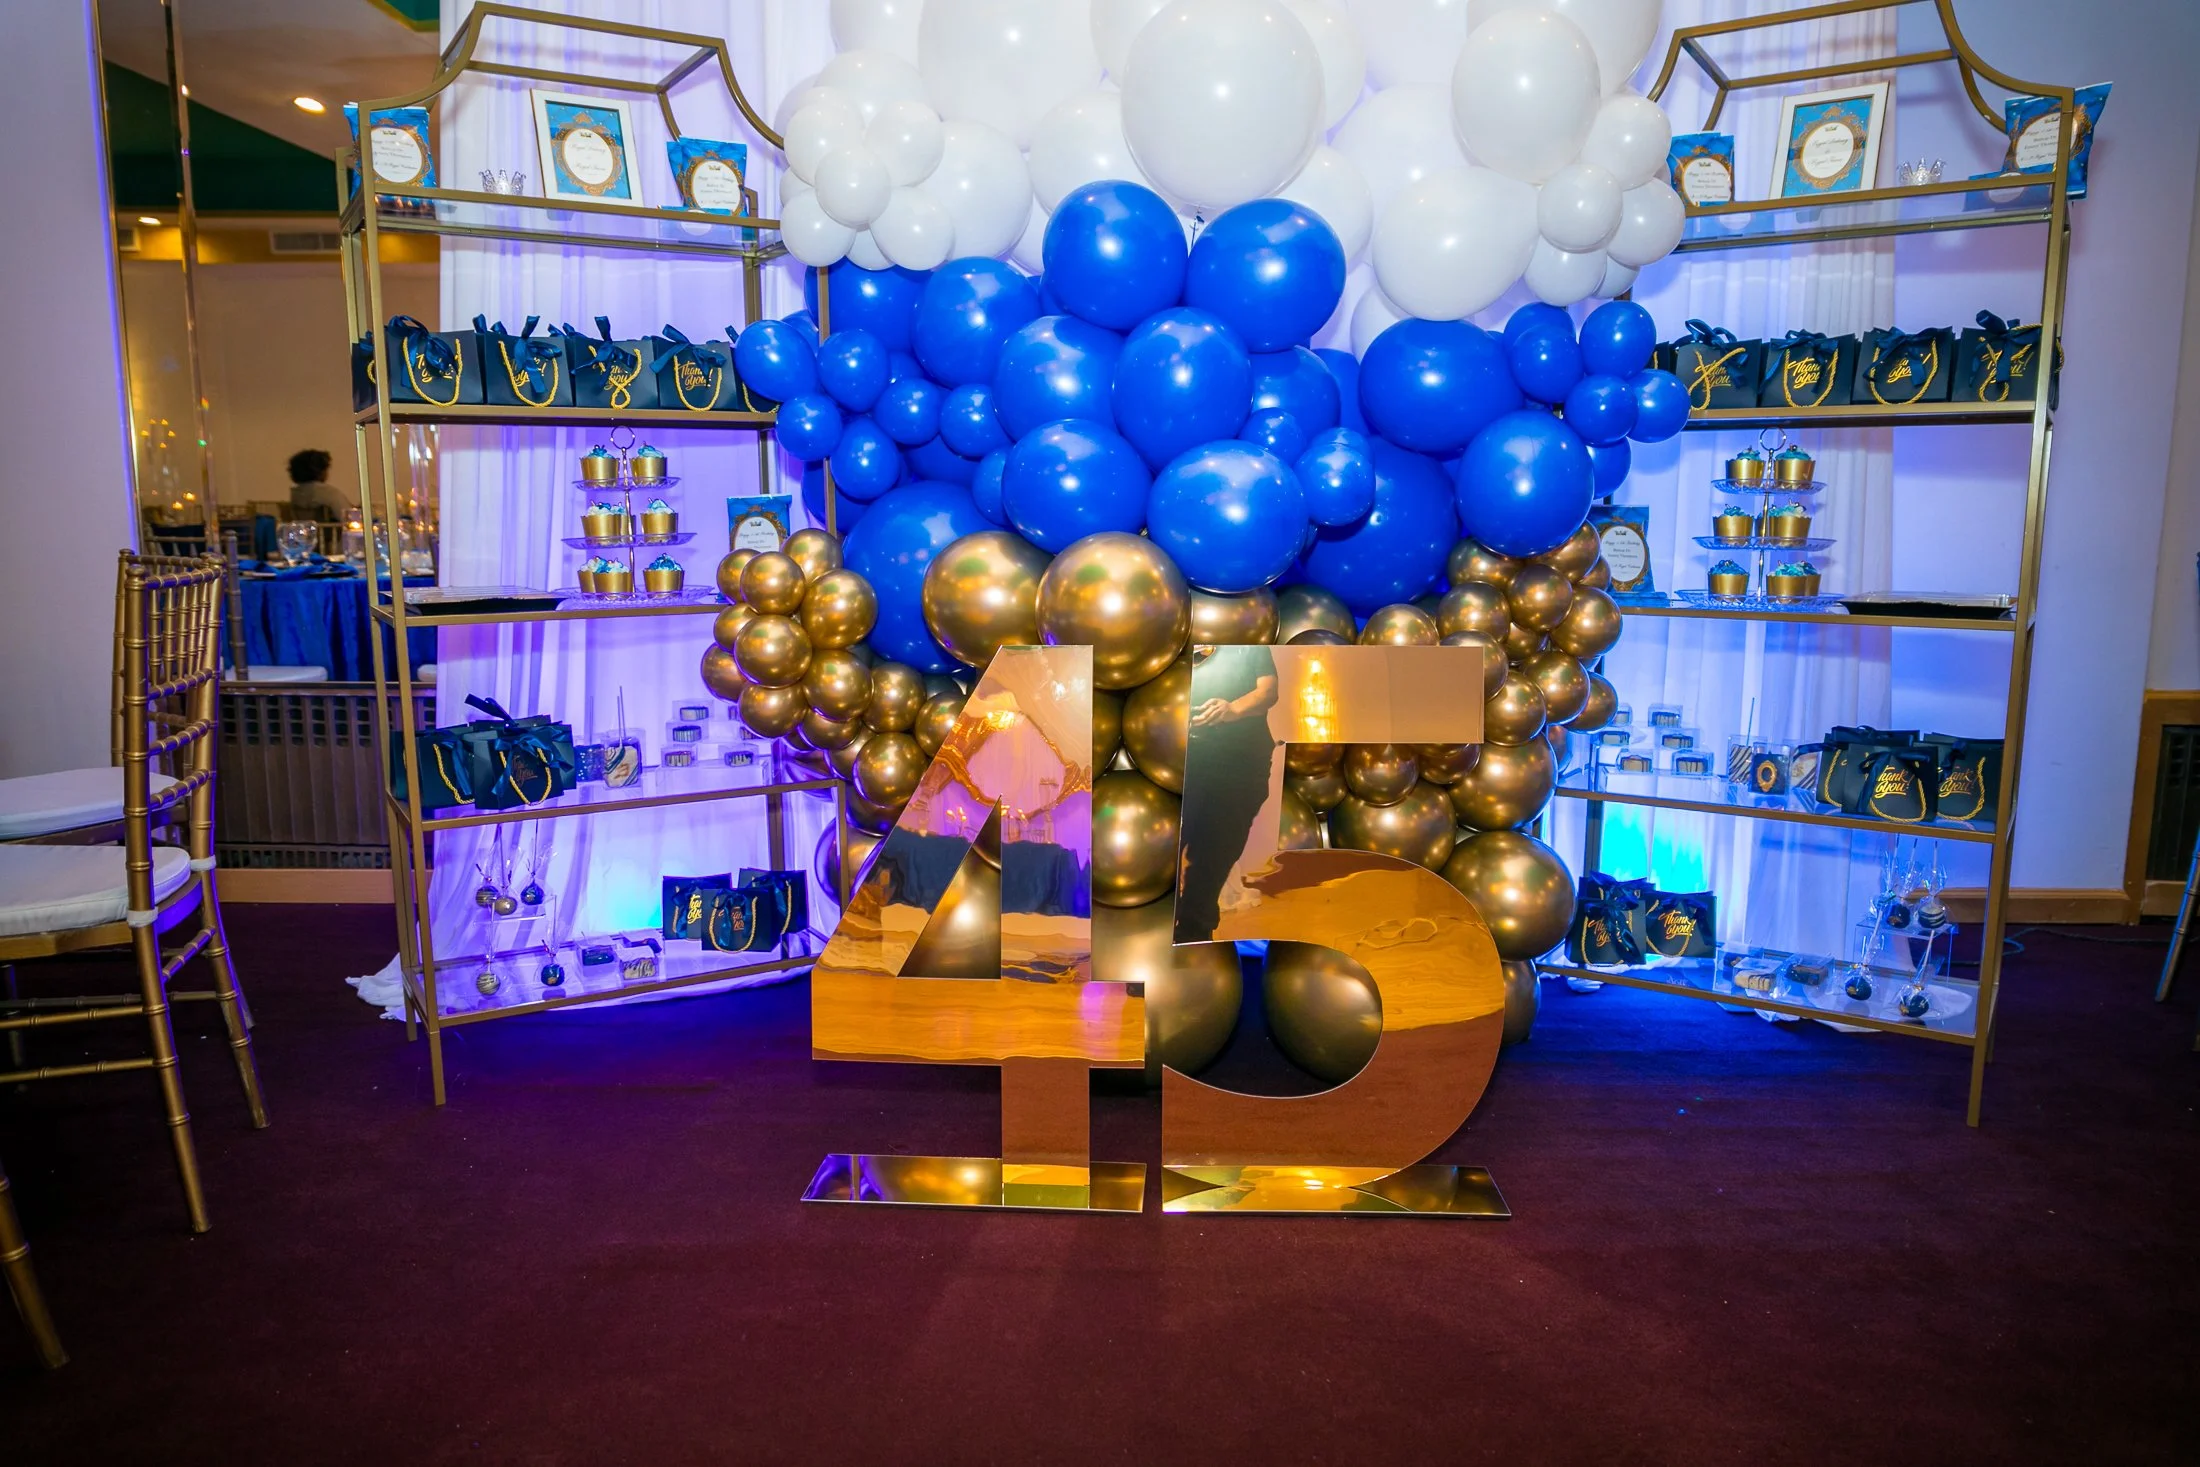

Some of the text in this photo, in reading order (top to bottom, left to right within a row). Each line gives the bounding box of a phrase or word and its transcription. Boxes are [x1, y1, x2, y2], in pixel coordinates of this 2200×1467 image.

[678, 361, 703, 378] Than
[1788, 357, 1821, 376] Than
[812, 645, 1505, 1187] 45
